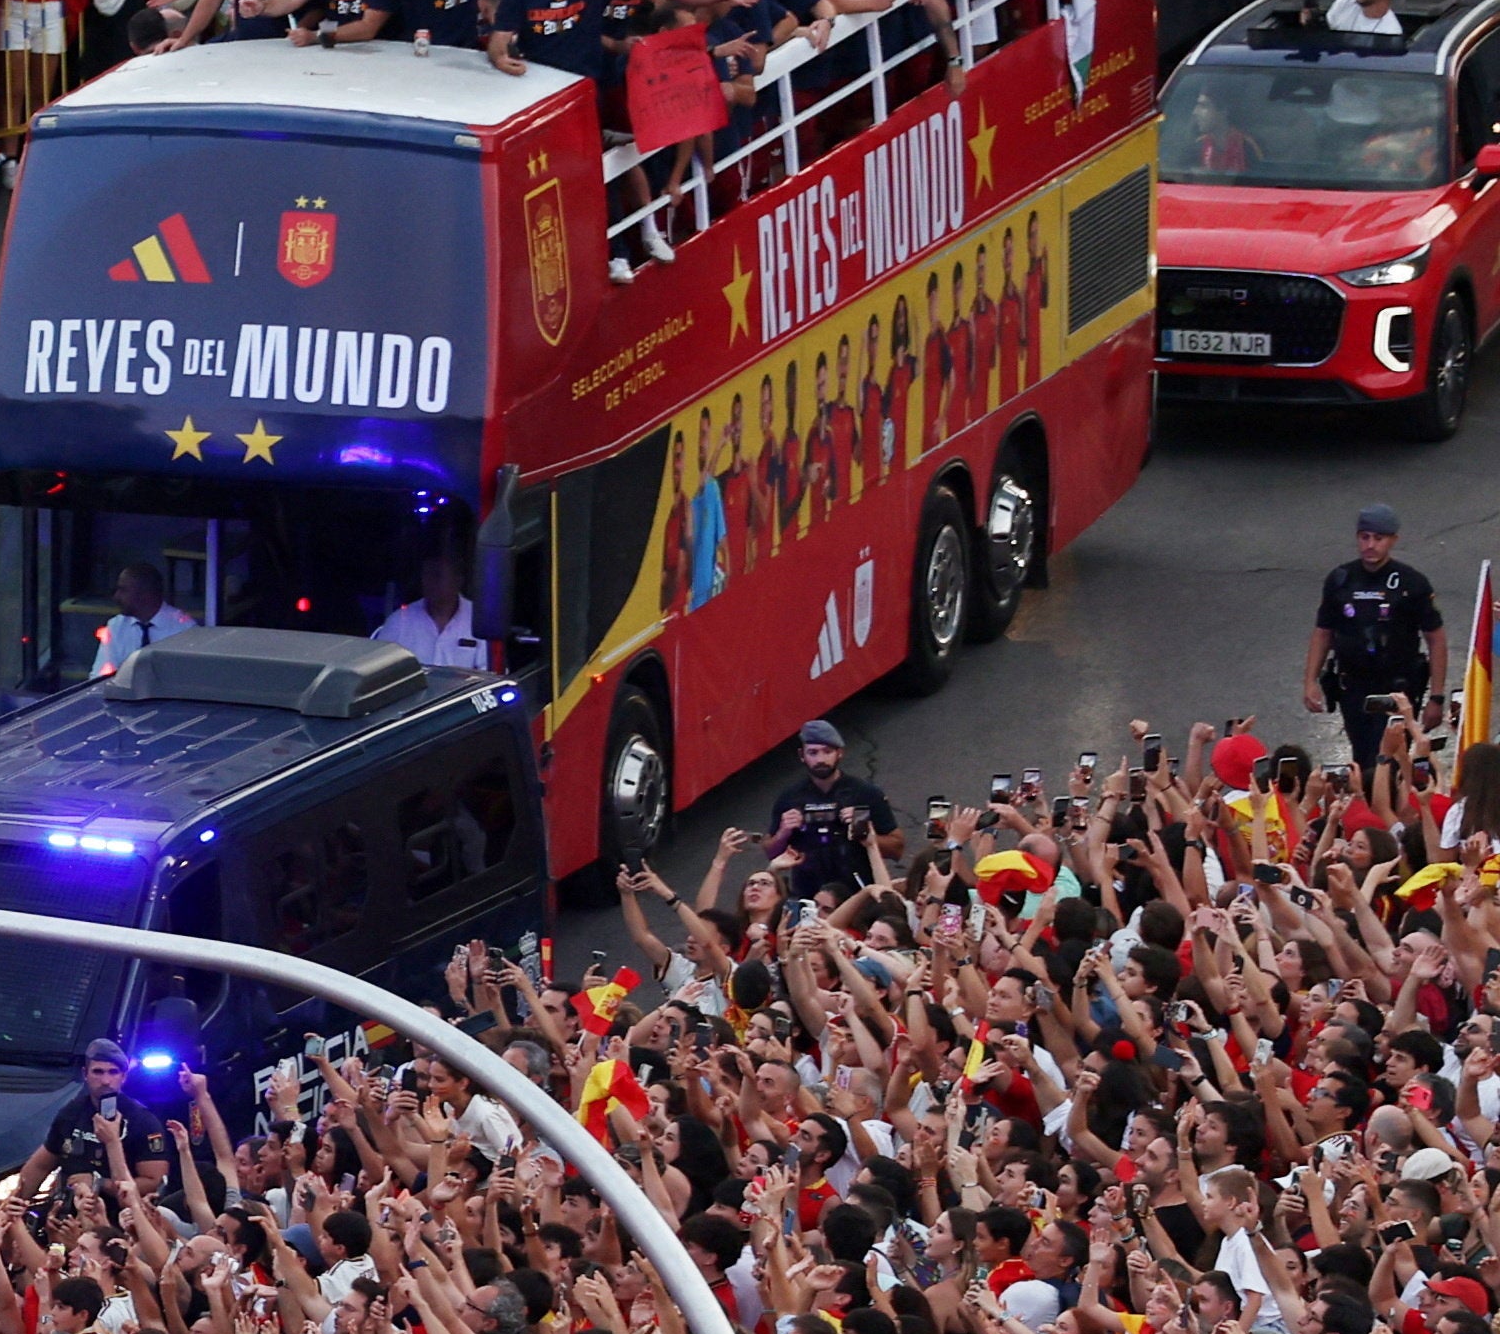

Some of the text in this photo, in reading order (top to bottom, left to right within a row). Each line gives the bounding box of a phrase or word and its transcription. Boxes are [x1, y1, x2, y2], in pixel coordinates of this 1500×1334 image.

[758, 101, 965, 343] REYES DEL MUNDO
[25, 318, 452, 414] REYES DEL MUNDO
[571, 308, 694, 402] SELECCIÓN ESPAÑOLA
[605, 361, 667, 411] DE FÚTBOL
[1177, 332, 1268, 357] 1632 NJR
